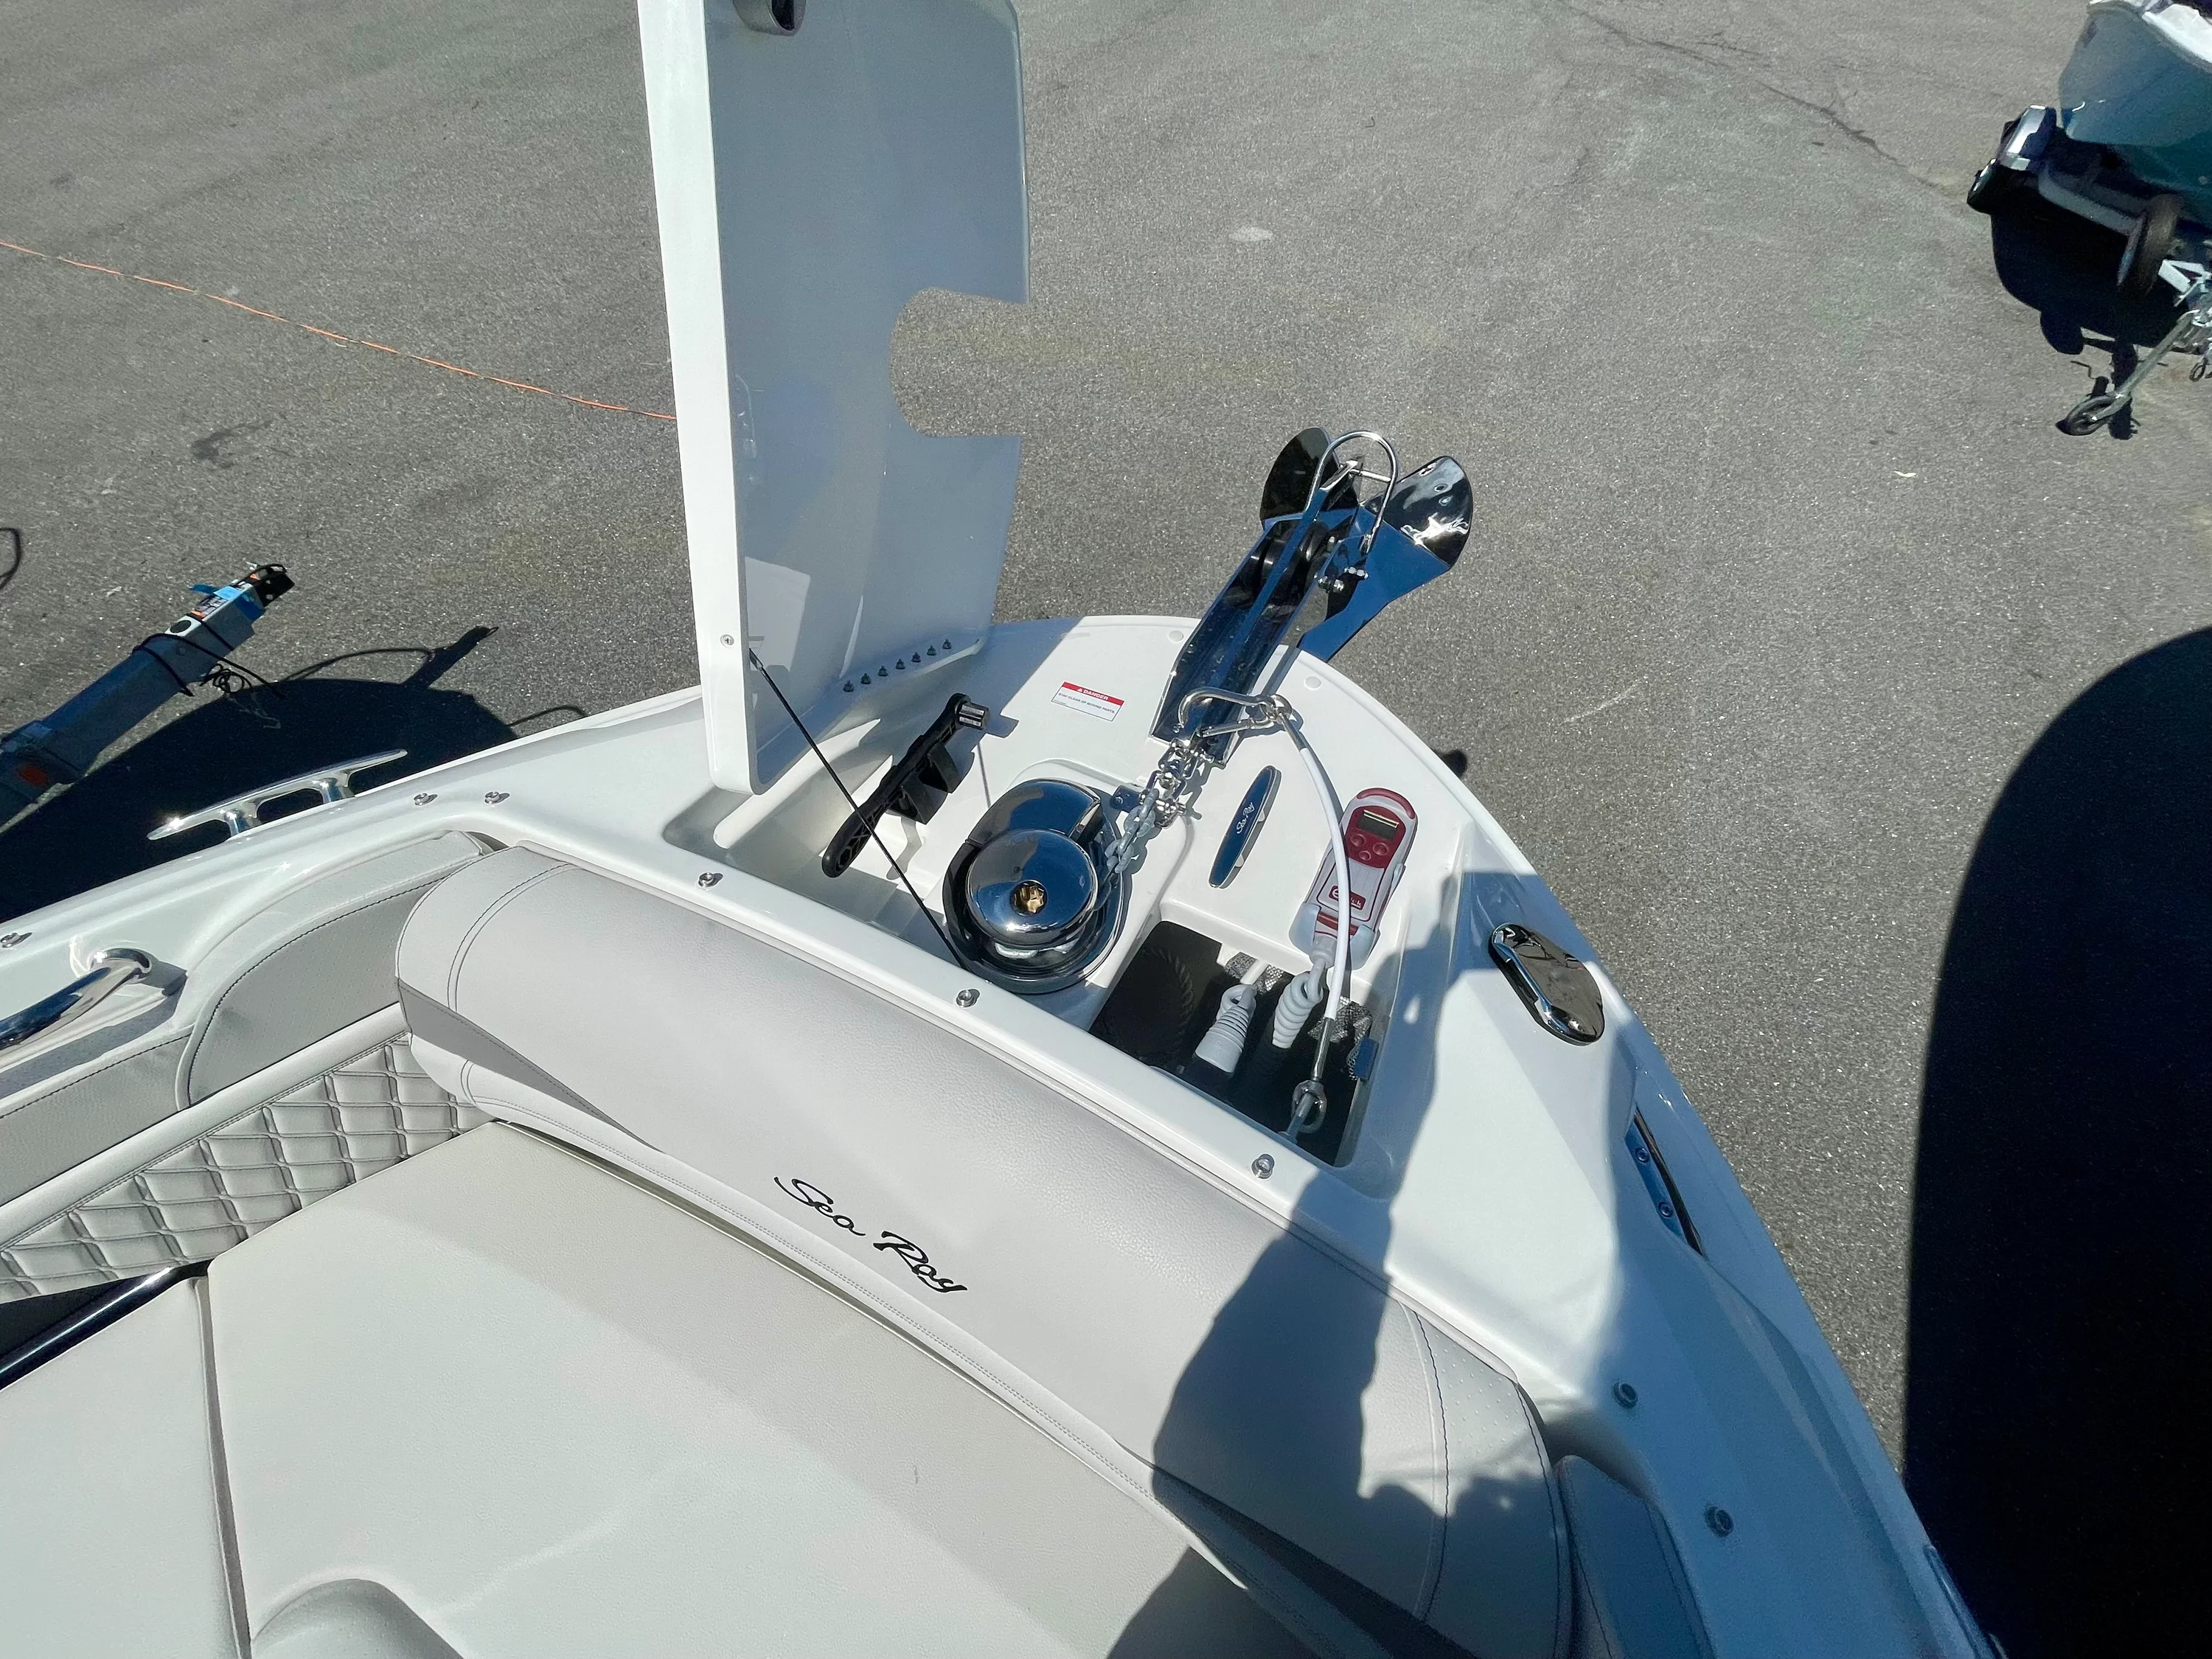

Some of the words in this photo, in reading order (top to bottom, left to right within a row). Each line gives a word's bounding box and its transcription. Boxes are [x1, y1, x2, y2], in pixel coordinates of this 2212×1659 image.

[1082, 689, 1109, 700] DANGER
[1236, 818, 1247, 834] Sea
[1242, 801, 1255, 818] Ray
[773, 1176, 866, 1237] Sea
[872, 1230, 968, 1293] Ray
